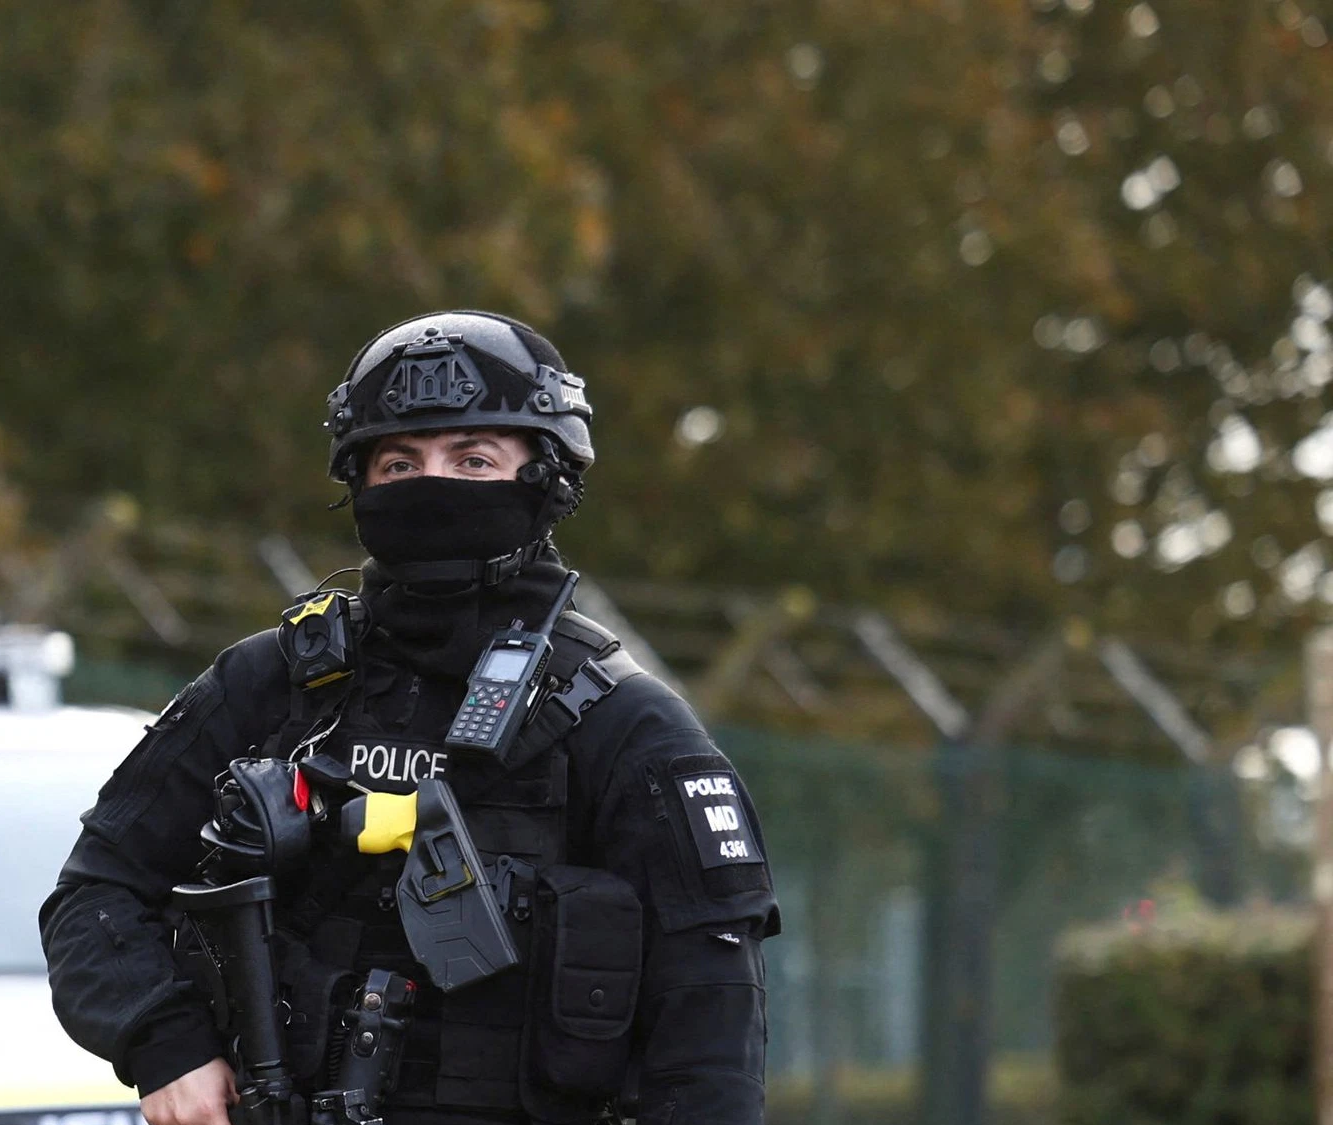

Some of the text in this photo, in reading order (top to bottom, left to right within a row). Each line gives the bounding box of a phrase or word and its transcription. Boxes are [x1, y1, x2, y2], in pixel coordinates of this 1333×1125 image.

[350, 744, 448, 784] POLICE
[683, 777, 737, 798] POLICE
[704, 805, 739, 832] MD
